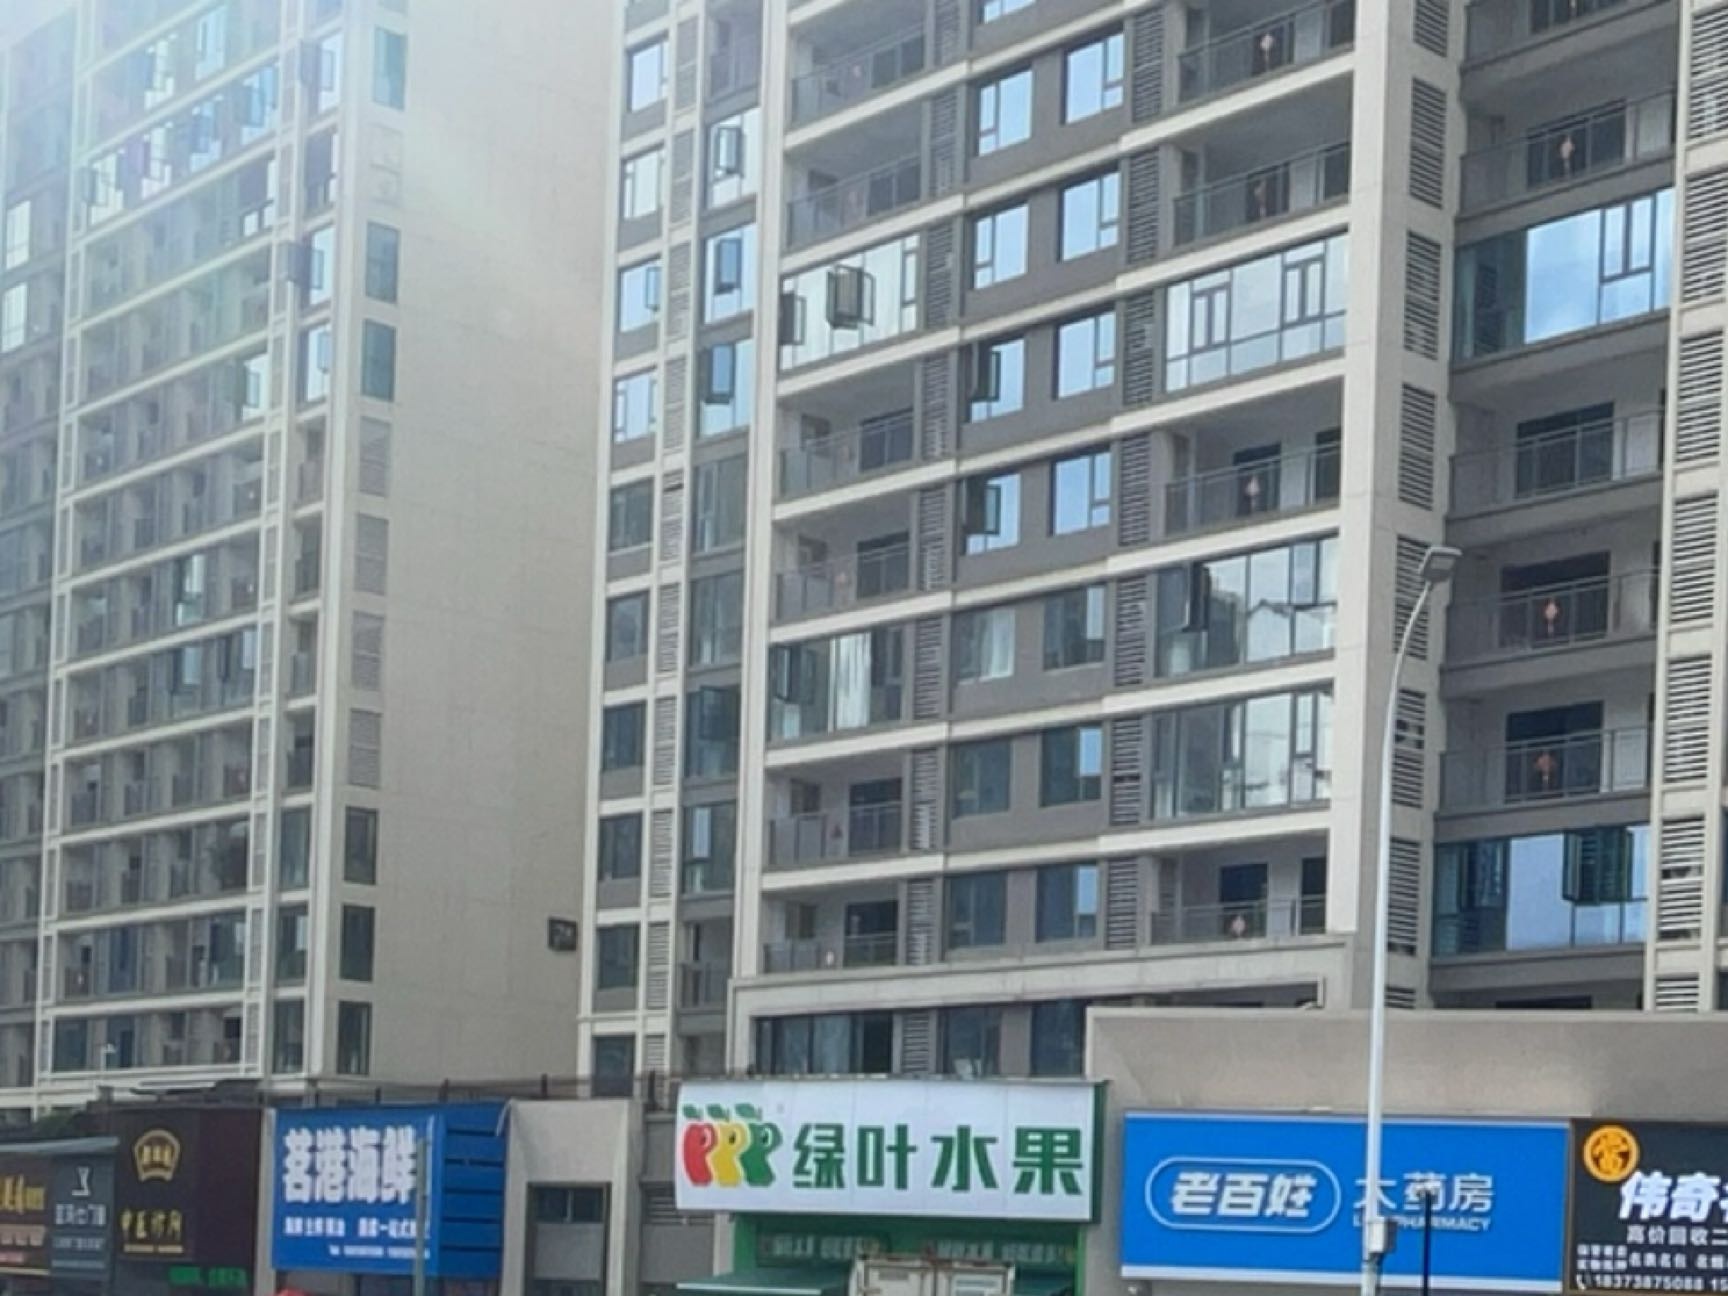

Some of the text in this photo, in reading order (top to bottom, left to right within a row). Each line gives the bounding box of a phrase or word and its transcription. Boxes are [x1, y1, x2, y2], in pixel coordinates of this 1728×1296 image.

[792, 1122, 1083, 1196] 绿叶水果
[1170, 1171, 1318, 1219] 老百姓
